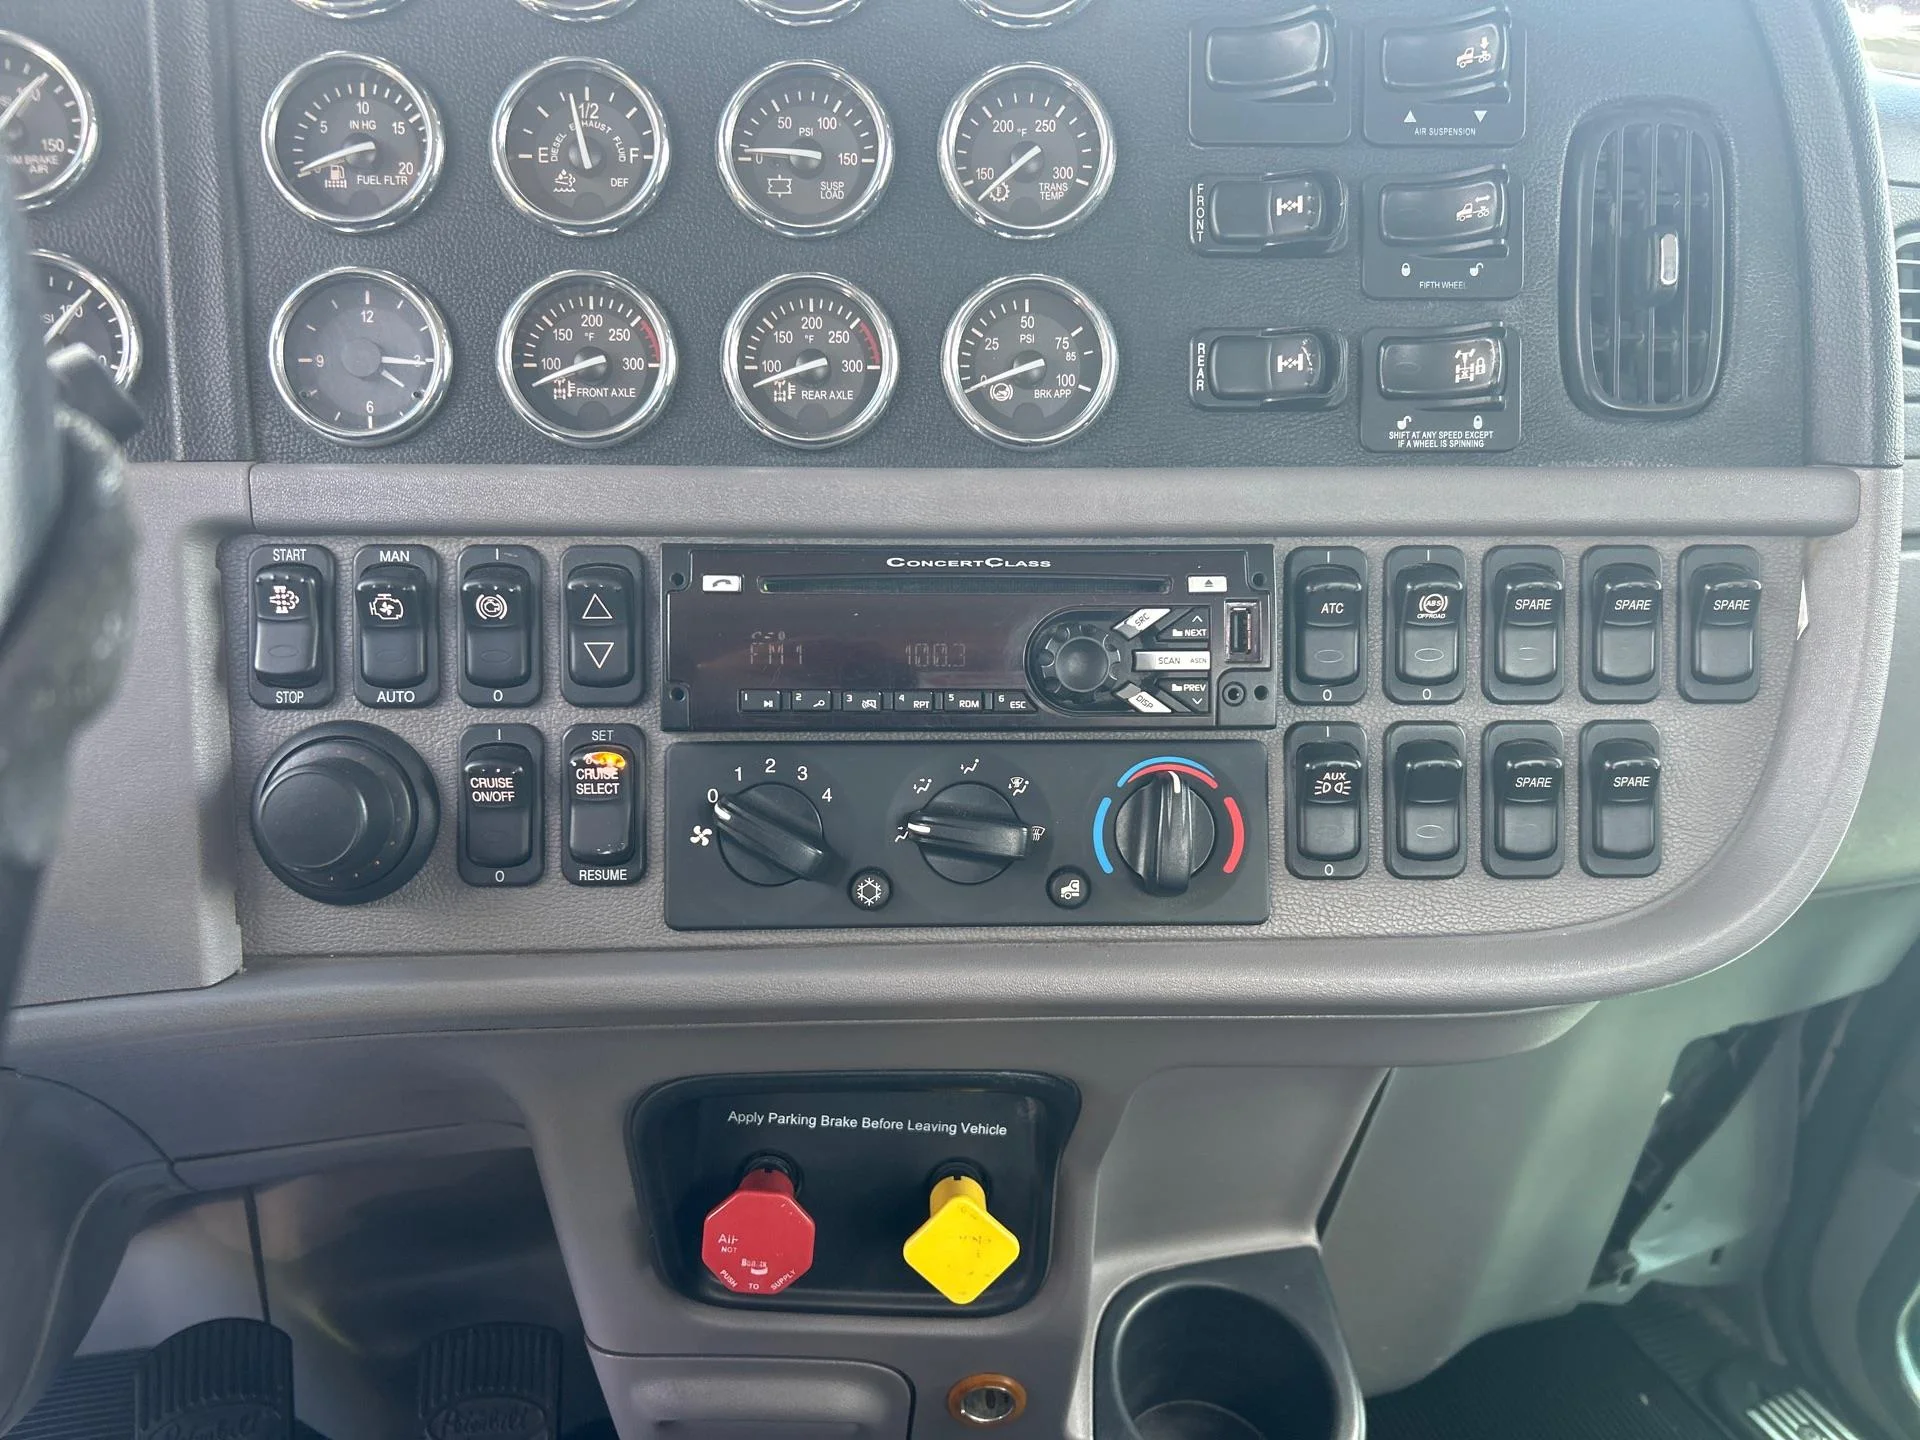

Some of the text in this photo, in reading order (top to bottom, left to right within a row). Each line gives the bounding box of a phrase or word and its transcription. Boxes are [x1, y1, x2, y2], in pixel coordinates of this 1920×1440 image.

[357, 102, 369, 114] 10
[578, 103, 599, 119] 1/2
[320, 121, 328, 134] 5
[350, 121, 376, 130] IN HG
[392, 122, 405, 134] 15
[778, 117, 792, 129] 50
[817, 117, 837, 129] 100
[993, 120, 1014, 132] 200
[1035, 120, 1056, 132] 250
[799, 128, 814, 137] PSI
[1414, 128, 1476, 136] AIR SUSPENSION
[42, 139, 65, 152] 150
[551, 120, 626, 162] DIESEL EHAUST FLUID
[538, 147, 549, 163] E
[630, 148, 639, 163] F
[838, 153, 858, 166] 150
[398, 162, 413, 175] 20
[976, 168, 994, 180] 150
[1052, 167, 1073, 179] 300
[357, 175, 408, 185] FUEL FLTR
[611, 178, 629, 187] DEF
[820, 181, 845, 191] SUSP
[1039, 182, 1068, 192] TRANS
[820, 191, 845, 200] LOAD
[1040, 191, 1065, 200] TEMP
[1196, 184, 1205, 242] FRONT
[1420, 281, 1440, 289] FIFTH
[361, 310, 374, 323] 12
[581, 314, 603, 327] 200
[1020, 316, 1035, 328] 50
[801, 317, 823, 329] 200
[553, 328, 573, 341] 150
[608, 329, 631, 341] 250
[774, 331, 793, 343] 150
[828, 331, 850, 344] 250
[1020, 334, 1035, 343] PSI
[985, 338, 999, 350] 25
[1055, 337, 1070, 350] 75
[316, 354, 324, 367] 9
[1065, 352, 1076, 361] 85
[541, 358, 561, 370] 100
[622, 358, 644, 370] 300
[762, 360, 781, 373] 100
[841, 360, 863, 373] 300
[1196, 343, 1206, 391] REAR
[1056, 374, 1075, 387] 100
[577, 388, 636, 397] FRONT AXLE
[801, 391, 854, 400] REAR AXLE
[1034, 389, 1071, 399] BRK APP
[366, 401, 374, 413] 6
[1389, 431, 1494, 440] SHIFT AT ANY SPEED EXCEPT
[1398, 440, 1485, 448] IF A WHEEL IS SPINNING
[273, 549, 307, 561] START
[379, 551, 410, 562] MAN
[1321, 602, 1344, 614] ATC
[1515, 599, 1552, 611] SPARE
[1614, 599, 1652, 611] SPARE
[1713, 599, 1750, 611] SPARE
[1134, 613, 1150, 628] SRC
[1184, 629, 1207, 637] NEXT
[1158, 657, 1181, 665] SCAN
[1183, 684, 1206, 692] PREV
[276, 691, 304, 704] STOP
[377, 691, 415, 703] AUTO
[744, 693, 748, 701] 1
[795, 693, 802, 701] 2
[846, 694, 853, 702] 3
[899, 694, 905, 702] 4
[948, 693, 955, 701] 5
[1135, 695, 1153, 709] DISP
[913, 700, 930, 709] RPT
[959, 700, 980, 708] RDM
[1010, 701, 1026, 709] ESC
[592, 730, 615, 741] SET
[765, 758, 776, 773] 2
[576, 768, 619, 780] CRUISE
[734, 767, 742, 782] 1
[797, 766, 808, 781] 3
[1323, 772, 1347, 781] AUX
[470, 777, 514, 788] CRUISE
[1515, 777, 1552, 788] SPARE
[1613, 776, 1650, 787] SPARE
[576, 783, 620, 795] SELECT
[472, 791, 515, 802] ON/OFF
[707, 788, 719, 803] 0
[821, 788, 833, 803] 4
[579, 869, 628, 881] RESUME
[728, 1111, 1008, 1136] Apply Parking Brake Before Leaving Vehicle
[719, 1269, 738, 1288] PUSH
[770, 1268, 797, 1291] SUPPLY
